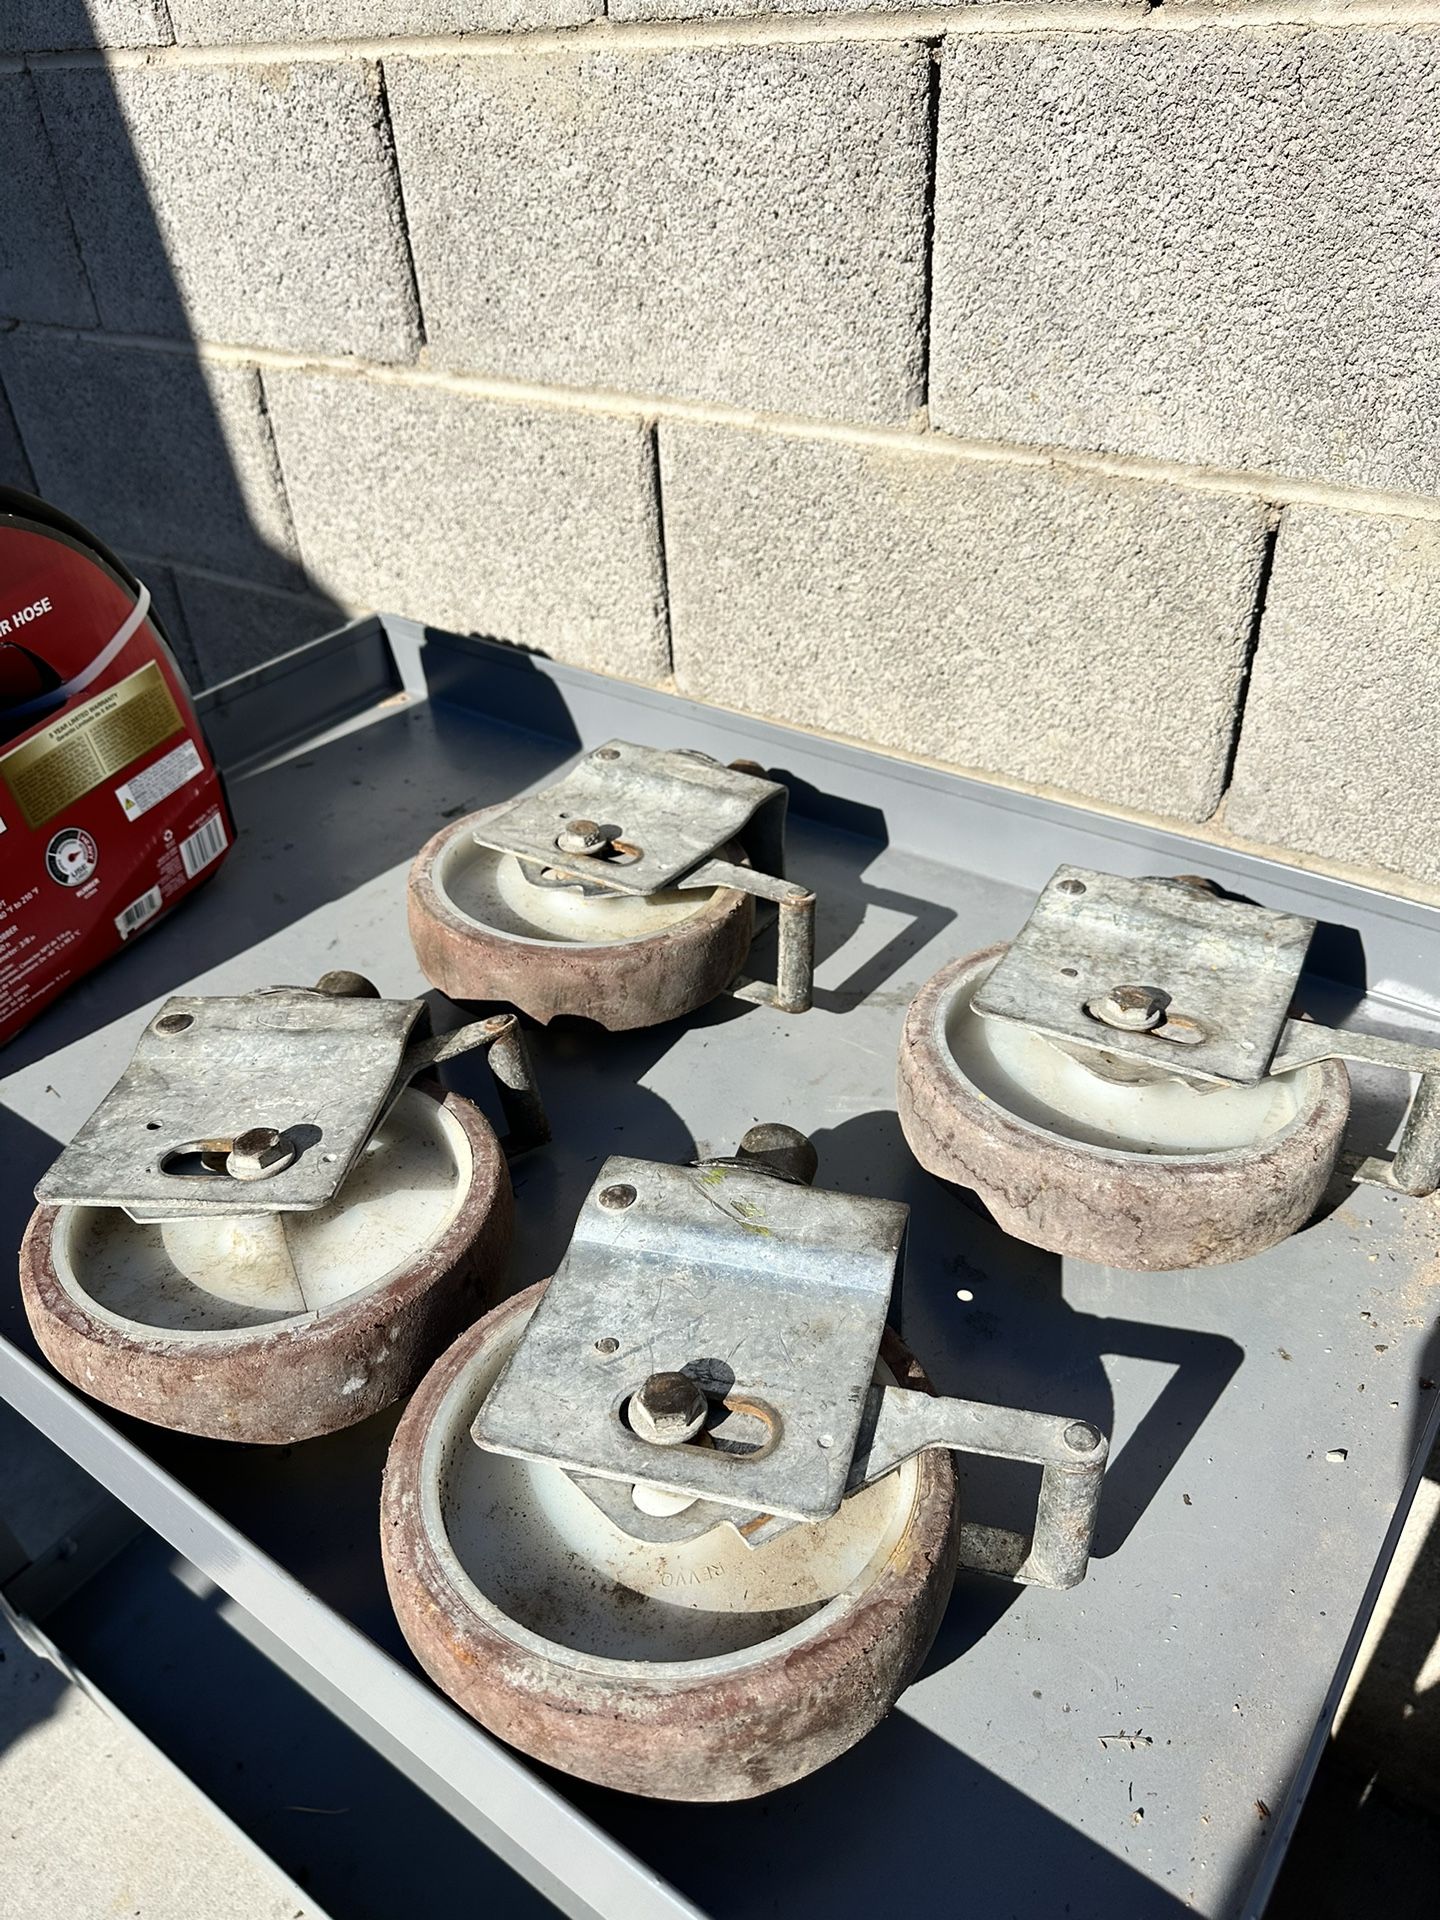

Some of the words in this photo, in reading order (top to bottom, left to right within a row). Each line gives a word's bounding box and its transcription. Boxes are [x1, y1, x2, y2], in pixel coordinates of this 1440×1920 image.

[0, 619, 13, 637] R
[11, 596, 53, 628] HOSE
[53, 723, 69, 734] YEAR
[68, 709, 90, 726] LIMITED
[89, 692, 118, 712] WARRANTY
[80, 834, 95, 861] HEAVY
[70, 863, 89, 878] USE
[13, 901, 22, 909] to
[20, 892, 34, 904] 210
[661, 1561, 726, 1587] REVVO
